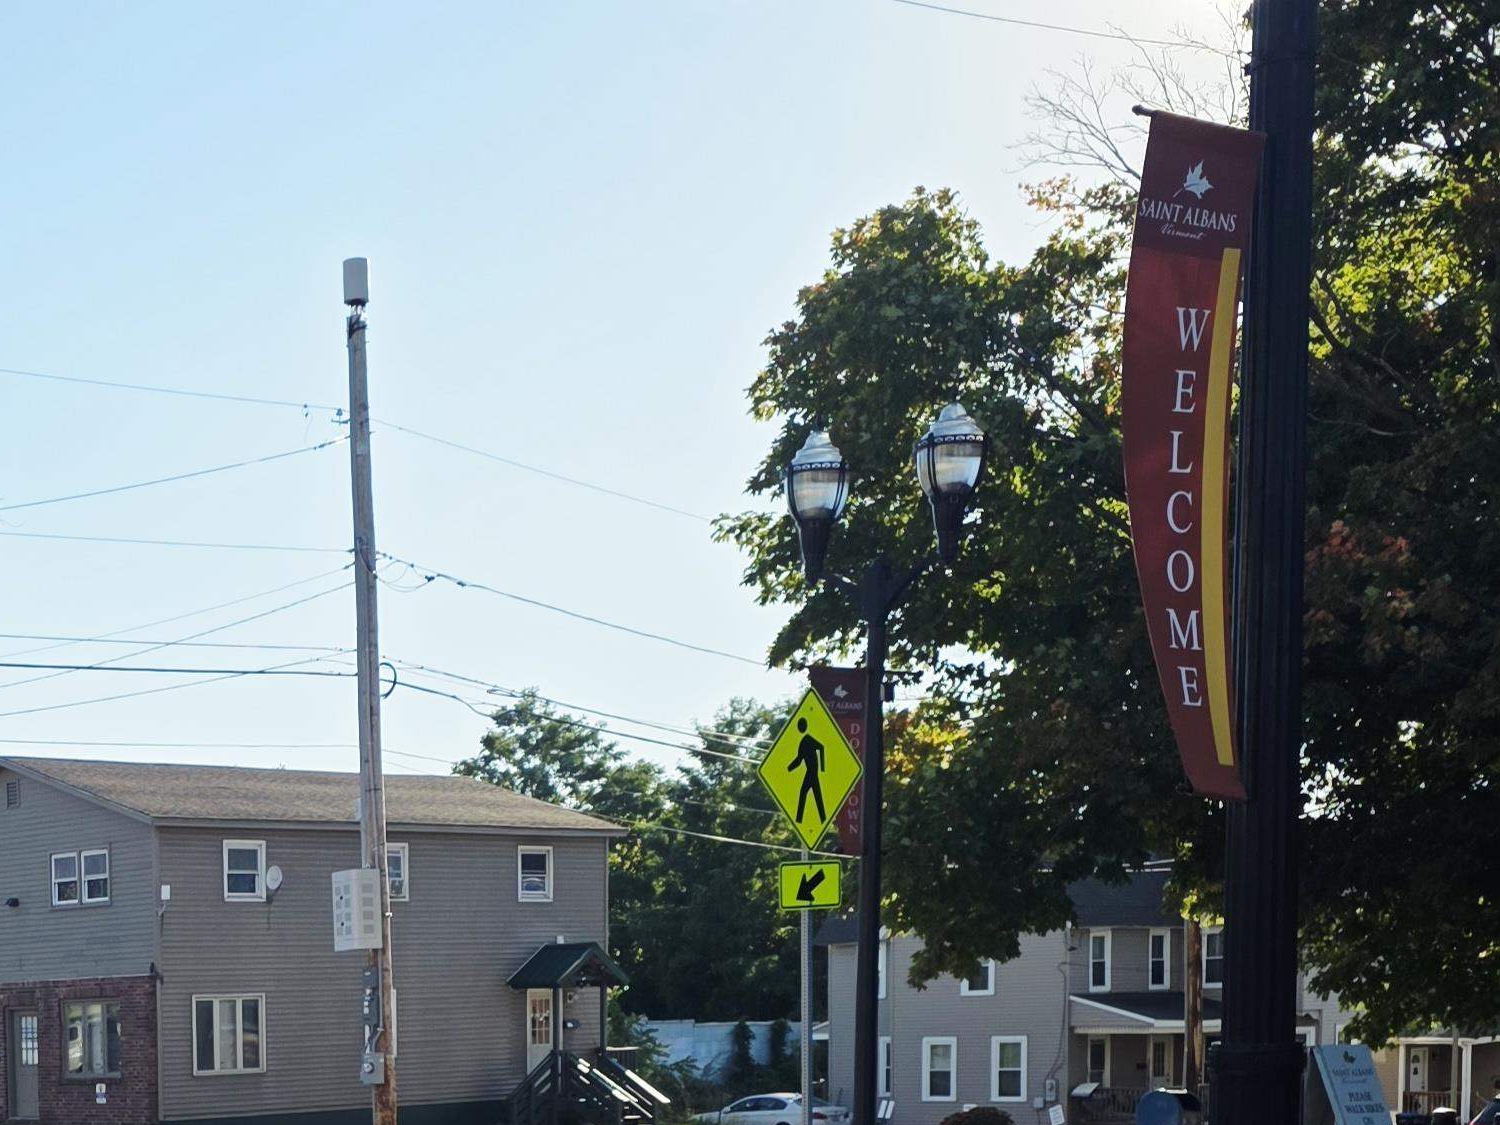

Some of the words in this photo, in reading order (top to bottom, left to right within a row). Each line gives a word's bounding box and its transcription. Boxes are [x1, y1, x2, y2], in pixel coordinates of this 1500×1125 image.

[1139, 199, 1183, 222] SAINT
[1183, 206, 1237, 232] ALBANS
[1160, 223, 1204, 240] Vermont
[1166, 307, 1211, 707] WELCOME
[847, 723, 861, 835] DOOWN
[1344, 1104, 1365, 1114] WALK
[1348, 1091, 1372, 1102] PLEASE
